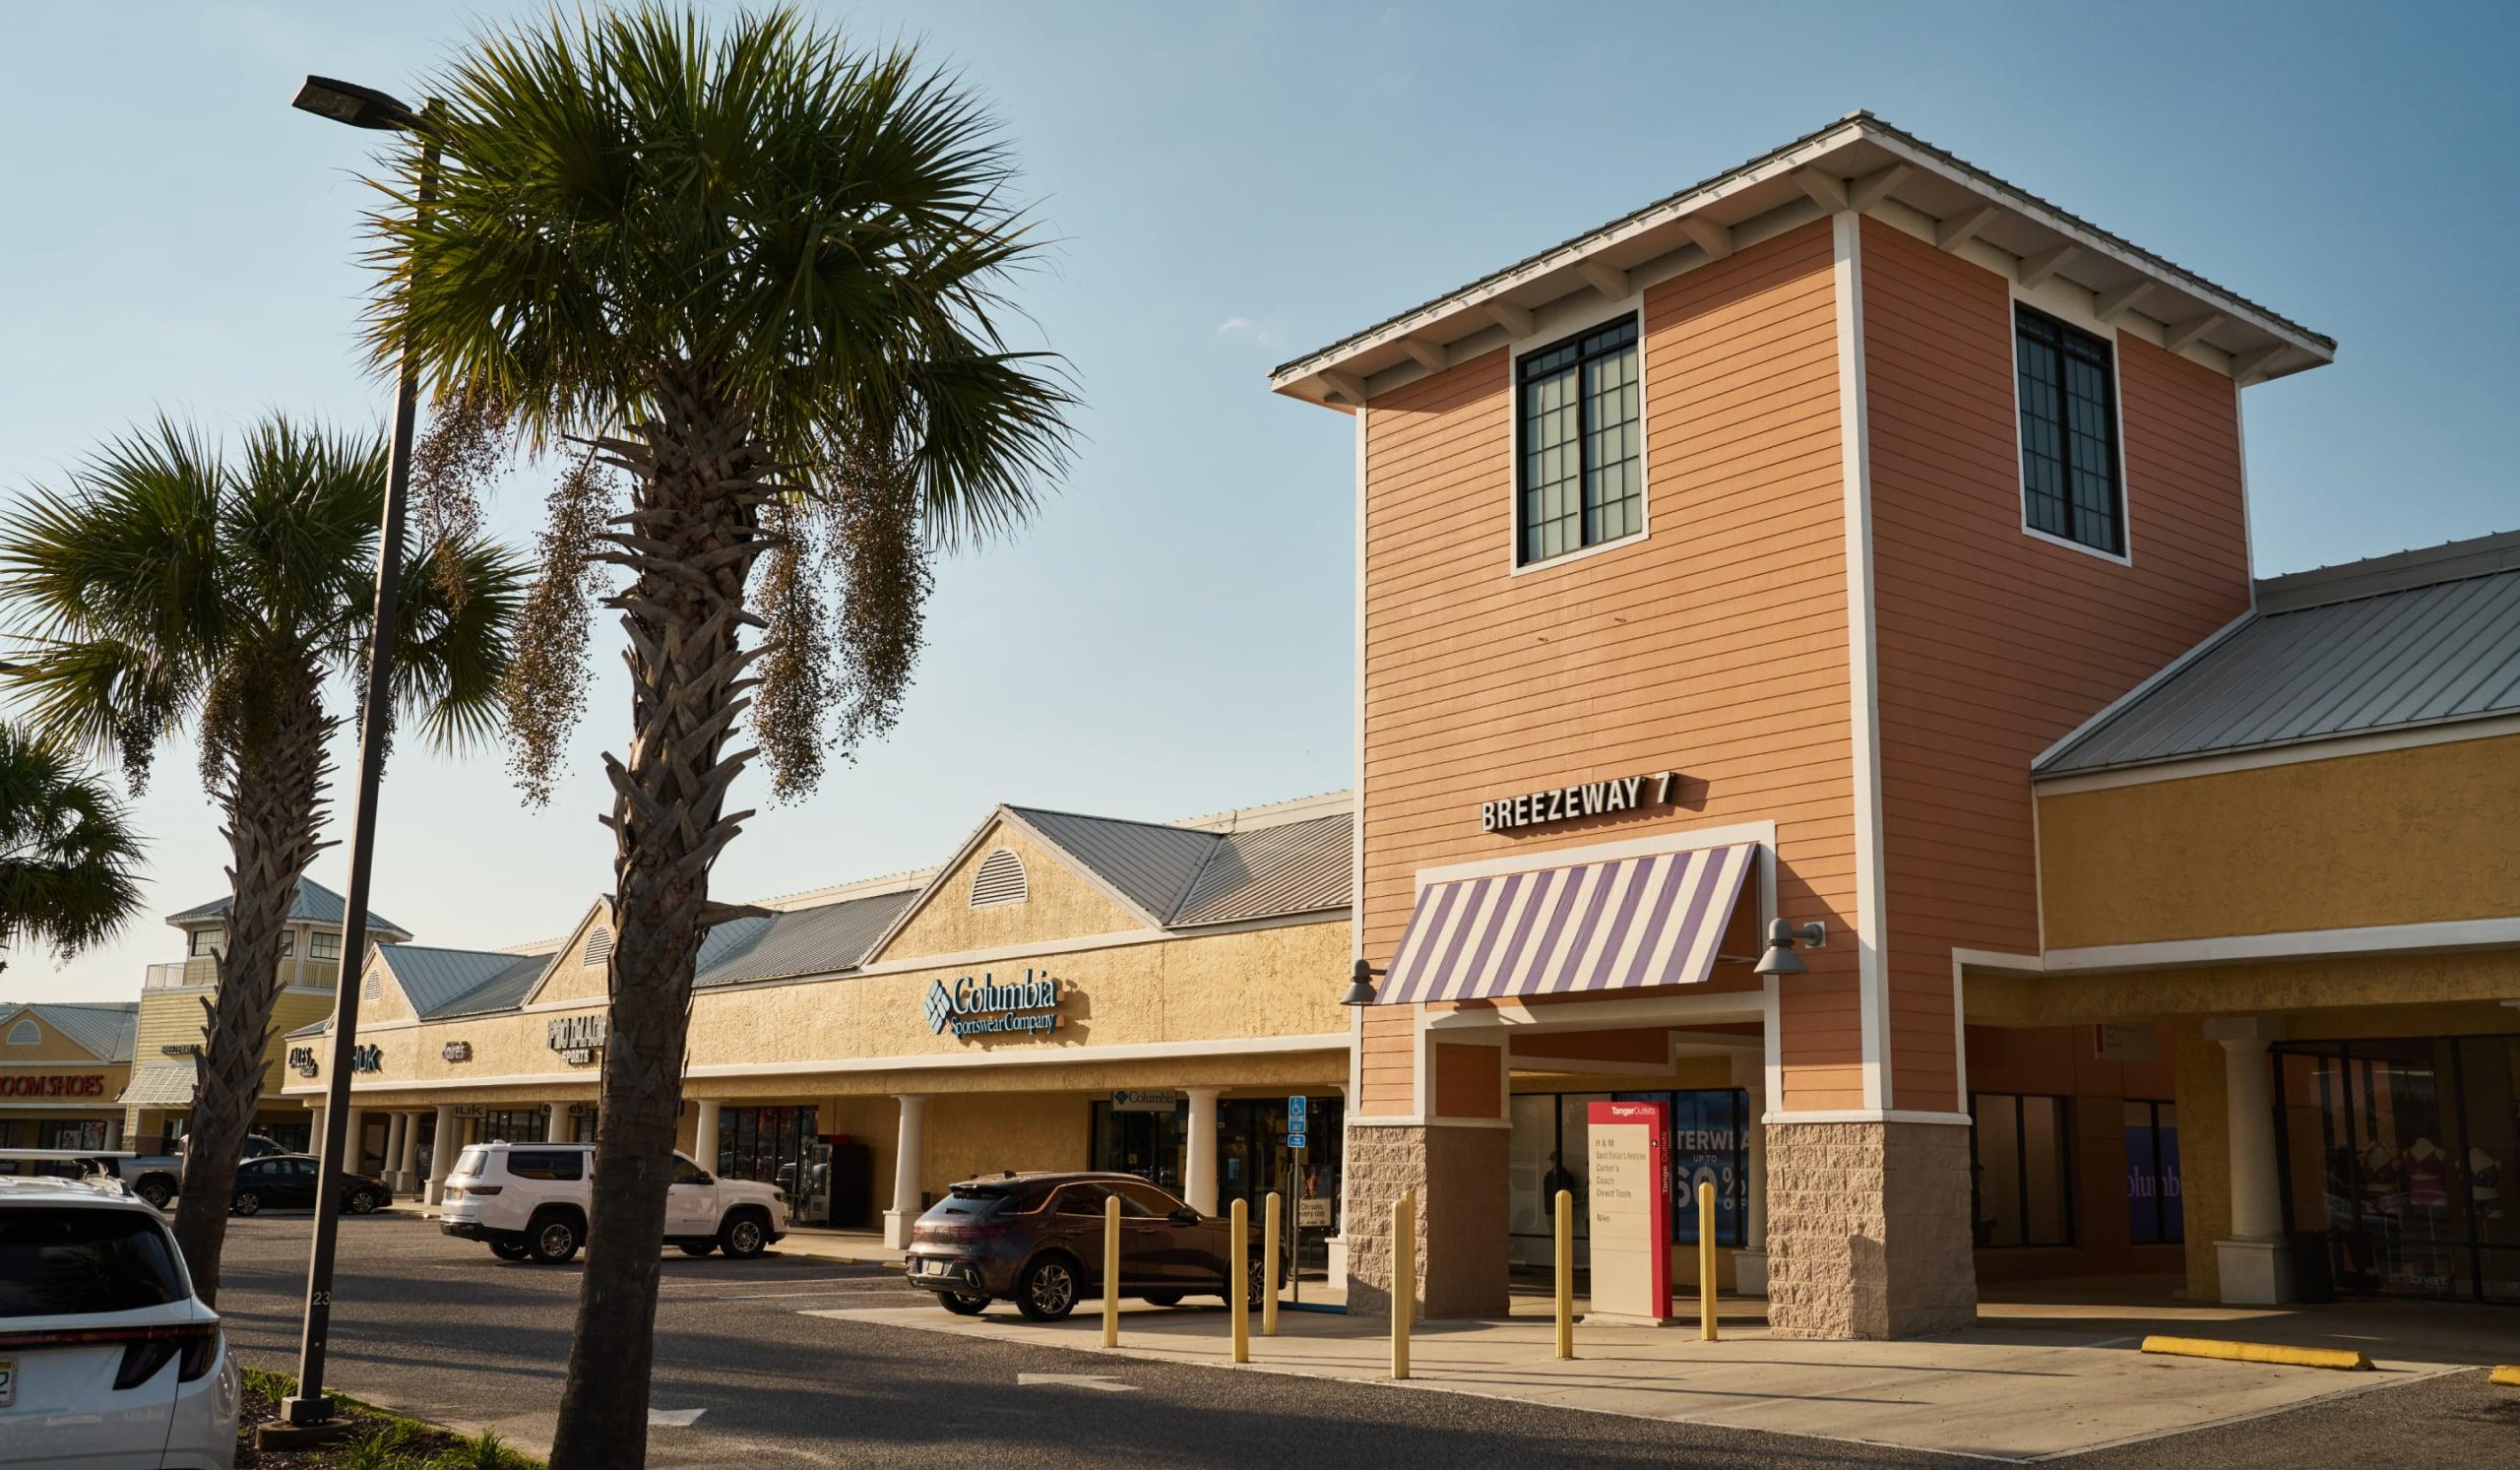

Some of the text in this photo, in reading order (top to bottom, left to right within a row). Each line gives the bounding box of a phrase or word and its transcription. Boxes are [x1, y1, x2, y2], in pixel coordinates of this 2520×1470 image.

[1482, 771, 1670, 831] BREEZEWAY 7
[951, 968, 1057, 1015] Columbia
[951, 1011, 1055, 1038] Sportswear Company
[547, 1018, 569, 1050] PRO
[561, 1050, 590, 1064] SPORTS
[0, 1075, 104, 1097] OOM SHOES
[1128, 1090, 1174, 1104] Columbia
[1693, 1154, 1718, 1163] UP TO
[1596, 1176, 1614, 1185] Coach
[1596, 1188, 1632, 1198] Direct Tools
[1597, 1213, 1610, 1223] Nike
[312, 1291, 331, 1306] 23
